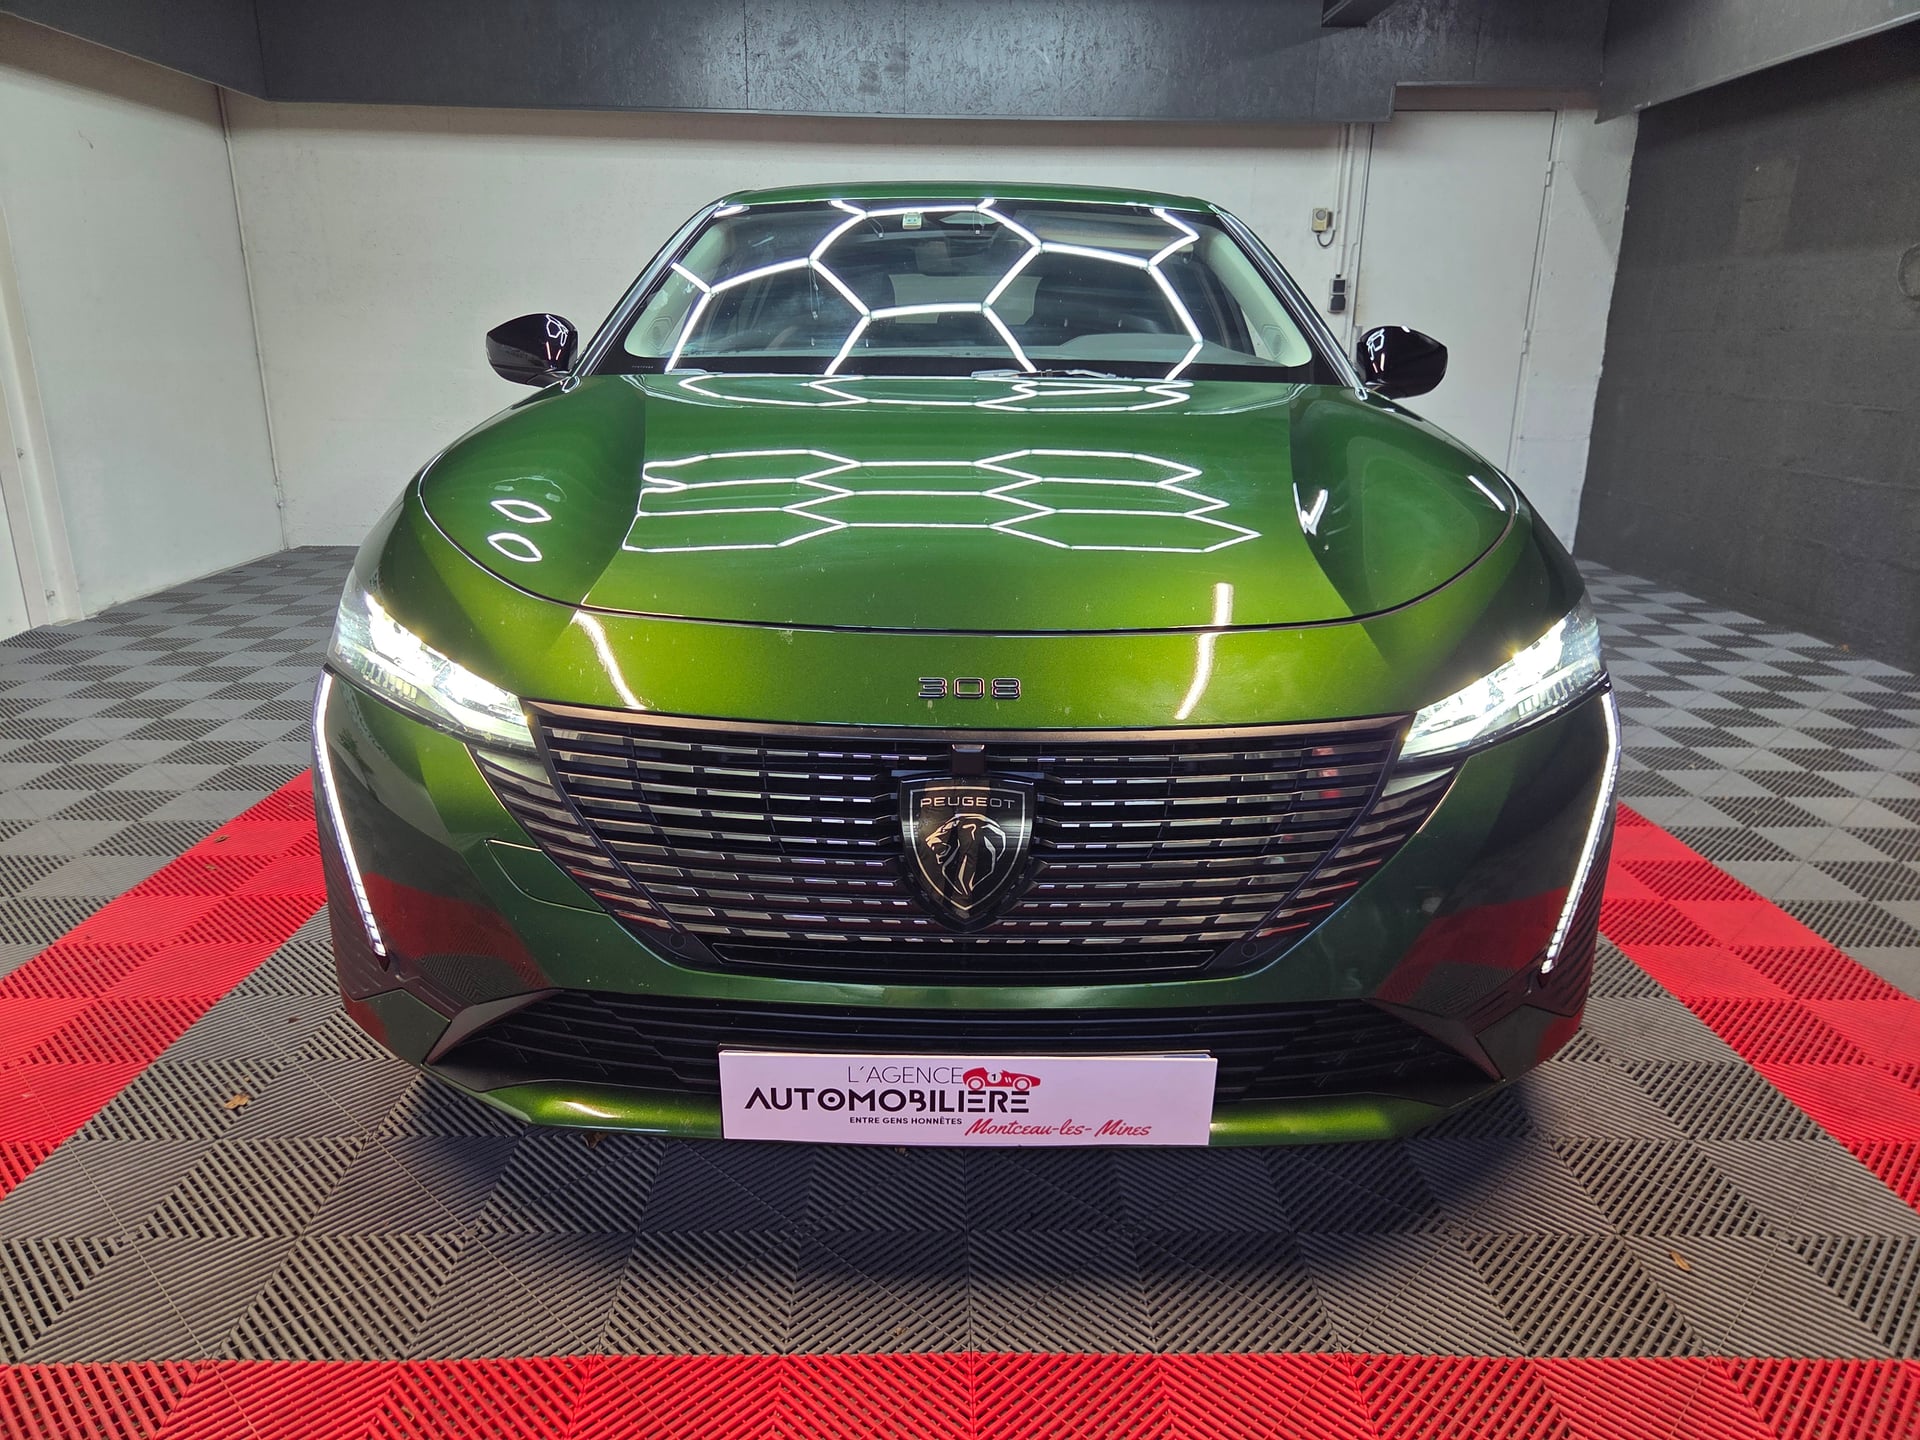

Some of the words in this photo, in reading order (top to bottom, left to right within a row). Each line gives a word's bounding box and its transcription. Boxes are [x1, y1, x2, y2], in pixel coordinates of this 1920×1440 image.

[918, 676, 1021, 699] 308
[920, 796, 1015, 809] PEUGEOT
[848, 1066, 963, 1085] L'AGENCE
[744, 1087, 1029, 1113] AUTOMOBILIERE
[850, 1116, 880, 1124] ENTRE
[911, 1116, 962, 1125] HONNÊTES
